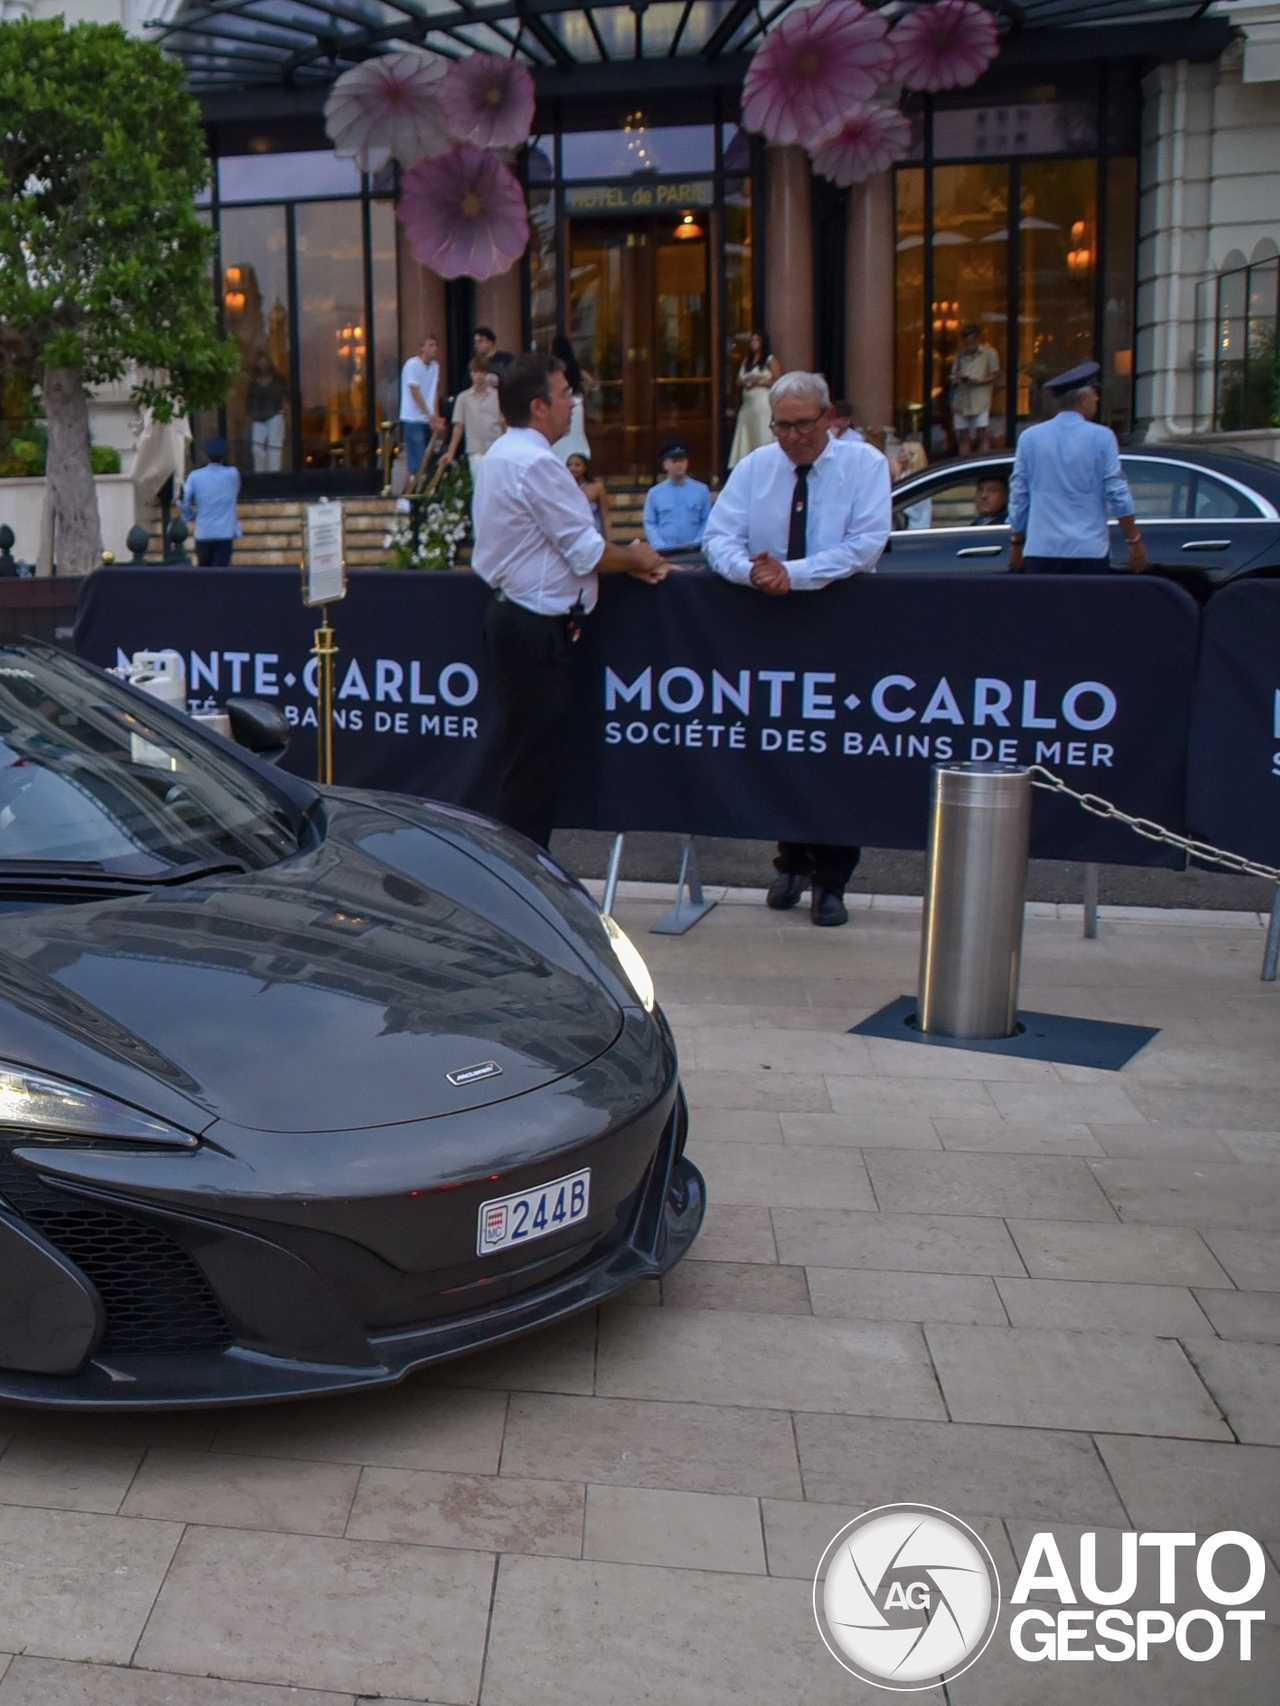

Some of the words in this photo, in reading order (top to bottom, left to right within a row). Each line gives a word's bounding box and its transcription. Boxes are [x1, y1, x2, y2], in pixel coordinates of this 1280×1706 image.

[302, 658, 479, 707] CARLO
[605, 665, 836, 719] MONTE
[871, 674, 1117, 731] CARLO
[284, 705, 363, 731] BANS
[374, 712, 410, 734] DE
[421, 715, 479, 739] MER
[604, 719, 747, 748] SOCIÉTÉ
[760, 728, 827, 753] DES
[843, 732, 953, 759] BAINS
[970, 738, 1018, 762] DE
[1035, 741, 1114, 767] MER
[487, 1226, 502, 1239] MC
[511, 1179, 585, 1240] 244B
